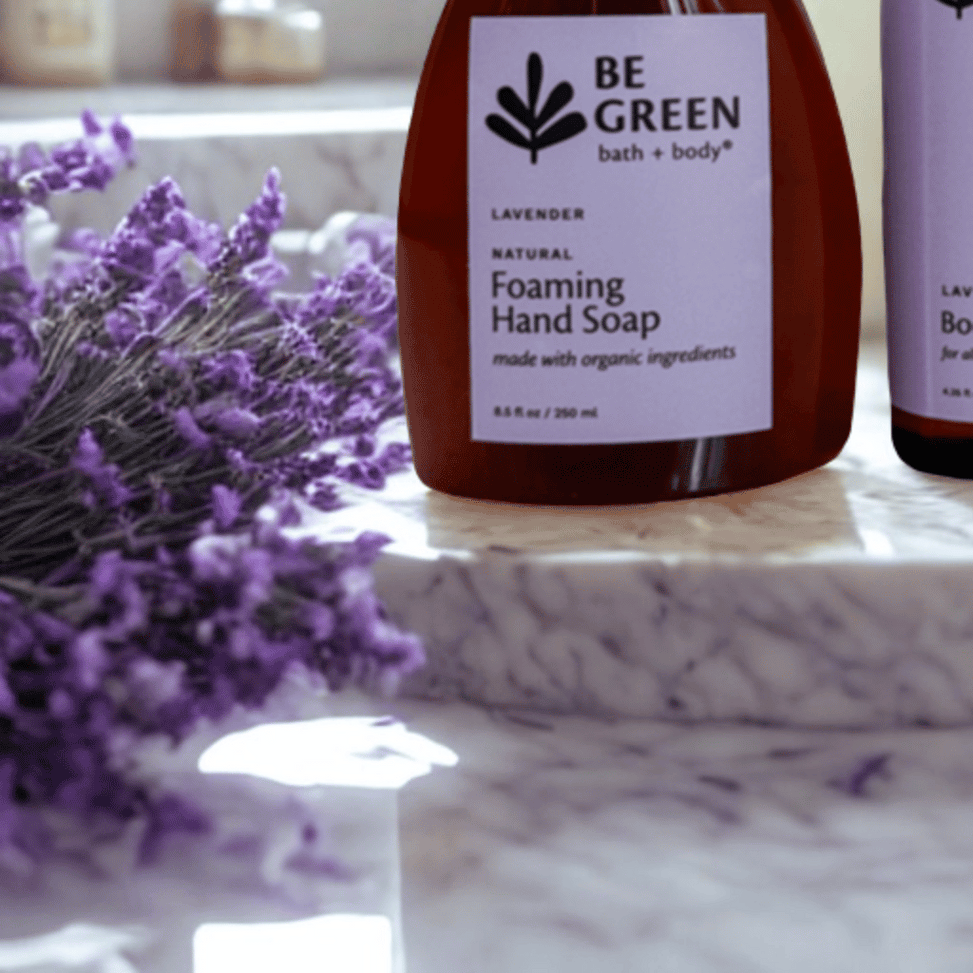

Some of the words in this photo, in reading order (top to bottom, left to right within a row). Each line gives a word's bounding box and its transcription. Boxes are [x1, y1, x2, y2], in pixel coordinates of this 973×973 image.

[595, 55, 645, 89] BE
[594, 95, 740, 133] GREEN
[598, 143, 644, 162] bath
[652, 148, 663, 159] +
[491, 207, 584, 221] LAVENDER
[491, 247, 573, 261] NATURAL
[491, 270, 626, 307] Foaming
[491, 303, 573, 334] Hand
[582, 304, 661, 340] Soap
[492, 349, 537, 367] made
[541, 350, 577, 367] with
[580, 350, 643, 371] organic
[647, 345, 736, 369] ingredients
